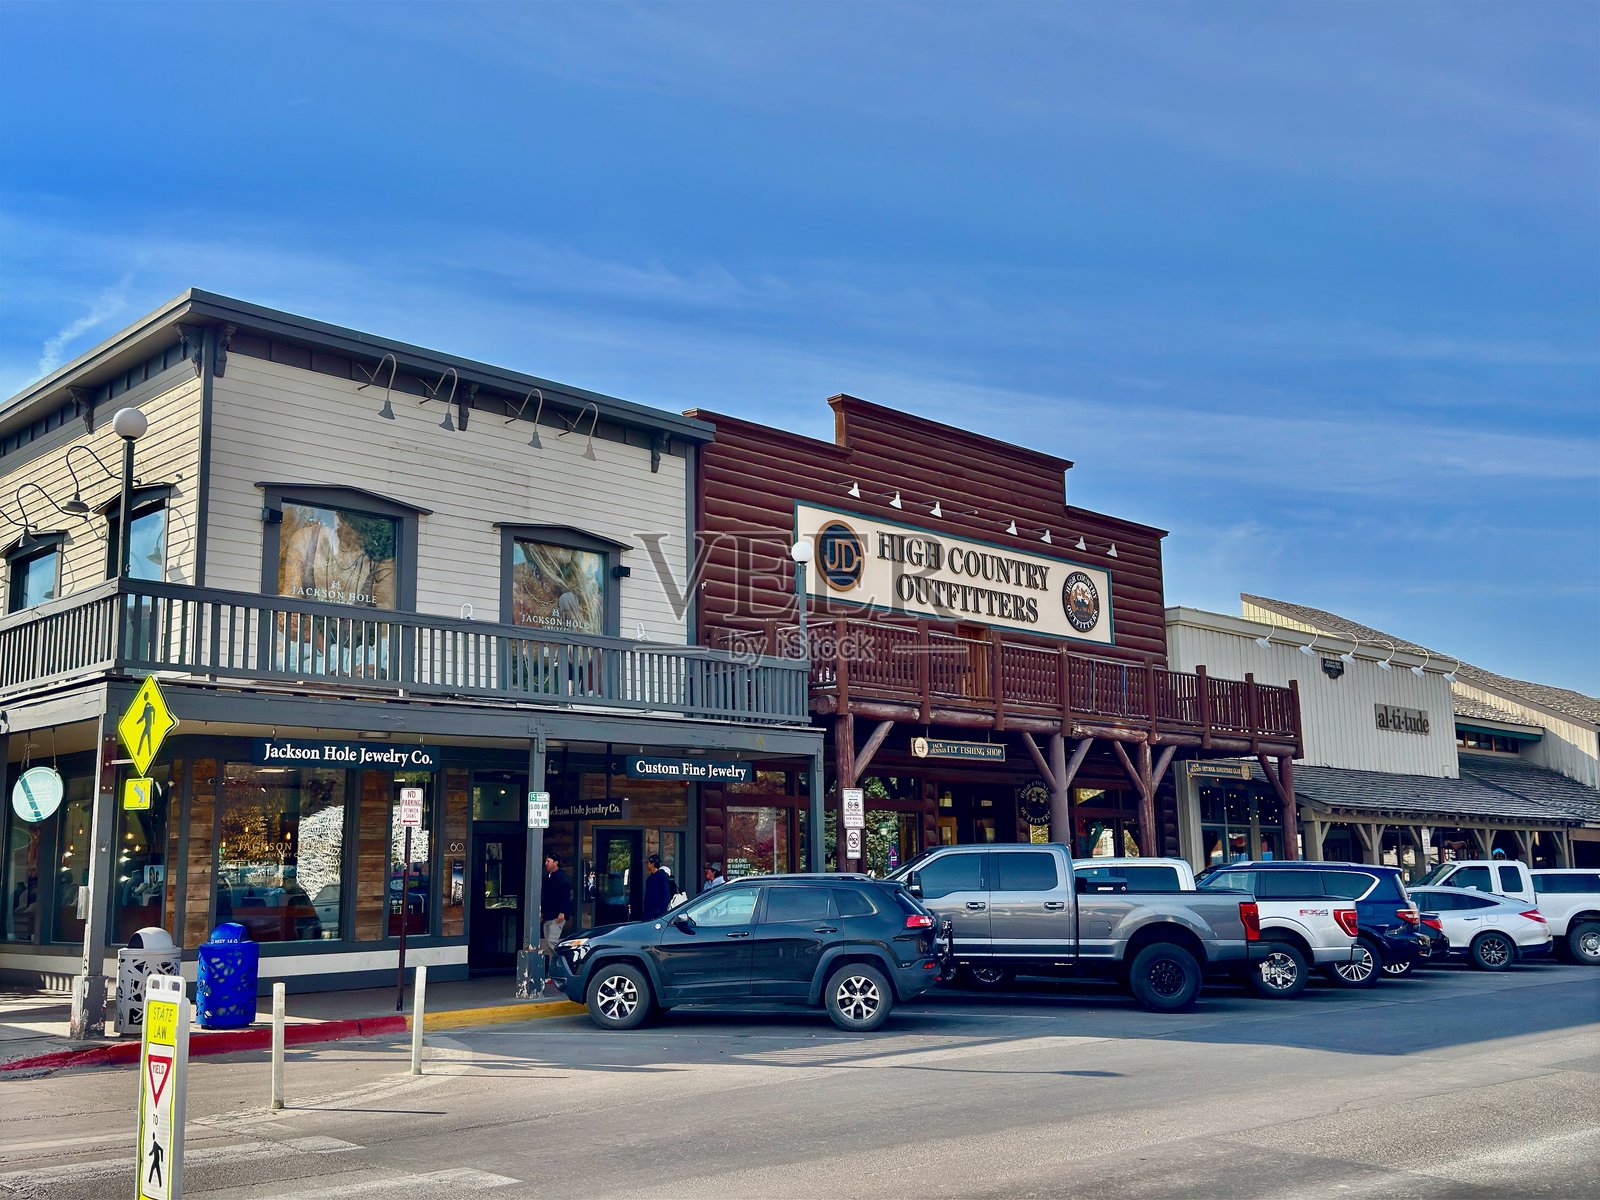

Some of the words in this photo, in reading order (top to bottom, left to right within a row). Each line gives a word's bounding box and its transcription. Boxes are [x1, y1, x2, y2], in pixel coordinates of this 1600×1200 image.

[876, 530, 942, 571] HIGH
[947, 547, 1051, 592] COUNTRY
[291, 585, 345, 601] JACKSON
[348, 592, 378, 604] HOLE
[1077, 573, 1099, 600] COUNTRY
[896, 573, 1039, 624] OUTFITTERS
[522, 614, 563, 627] JACKSON
[566, 619, 589, 630] HOLE
[1066, 603, 1099, 631] OUTFITTERS
[264, 743, 320, 760] Jackson
[323, 746, 357, 761] Hole
[359, 747, 409, 768] Jewelry
[411, 750, 433, 765] Co.
[960, 746, 985, 756] FISHING
[986, 748, 1002, 756] SHOP
[636, 760, 680, 775] Custom
[682, 762, 706, 776] Fine
[707, 764, 747, 781] Jewelry
[407, 790, 416, 798] NO
[570, 804, 585, 815] Hole
[585, 803, 609, 816] Jewelry
[238, 842, 293, 852] JACKSON
[450, 841, 465, 852] 60
[153, 1005, 174, 1023] STATE
[153, 1024, 168, 1040] LAW
[152, 1064, 165, 1075] YIELD
[153, 1113, 159, 1126] TO
